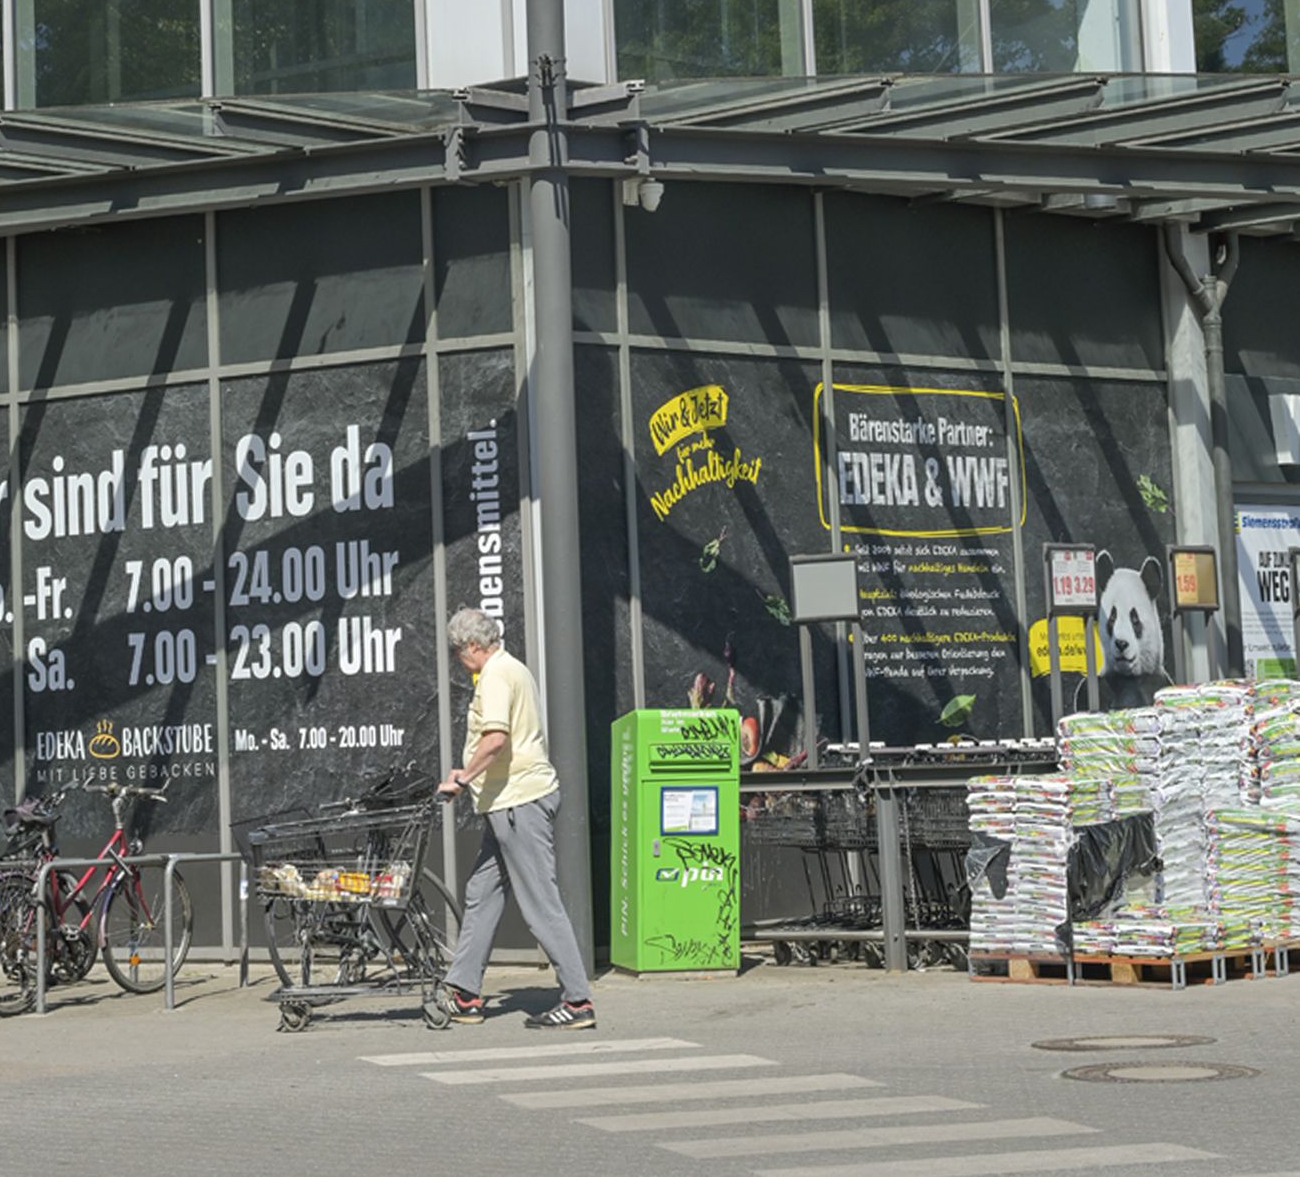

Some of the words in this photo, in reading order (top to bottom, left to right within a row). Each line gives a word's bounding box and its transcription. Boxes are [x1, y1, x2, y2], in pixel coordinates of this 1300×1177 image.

[651, 412, 679, 446] Wir
[690, 392, 724, 425] Jetzt
[848, 413, 935, 444] Bärenstarke
[938, 417, 993, 447] Partner:
[23, 449, 125, 540] sind
[137, 443, 212, 529] für
[236, 431, 314, 521] Sie
[331, 424, 394, 513] da
[650, 447, 762, 522] Nachhaltigkeit
[838, 451, 919, 506] EDEKA
[924, 456, 943, 508] &
[947, 455, 1008, 508] WWF
[467, 418, 505, 650] bensmittel.
[125, 555, 193, 613] 7.00
[228, 546, 325, 606] 24.00
[336, 540, 399, 599] Uhr
[27, 636, 75, 692] Sa.
[128, 629, 196, 686] 7.00
[230, 621, 325, 679] 23.00
[338, 616, 401, 675] Uhr
[36, 730, 85, 761] EDEKA
[122, 723, 213, 758] BACKSTUBE
[234, 729, 259, 751] Mo.
[270, 727, 290, 750] Sa.
[299, 726, 327, 749] 7.00
[338, 726, 376, 748] 20.00
[379, 724, 404, 747] Uhr
[36, 768, 63, 782] MIT
[72, 766, 117, 781] LIEBE
[126, 762, 216, 780] GEBACKEN
[681, 860, 723, 888] pin
